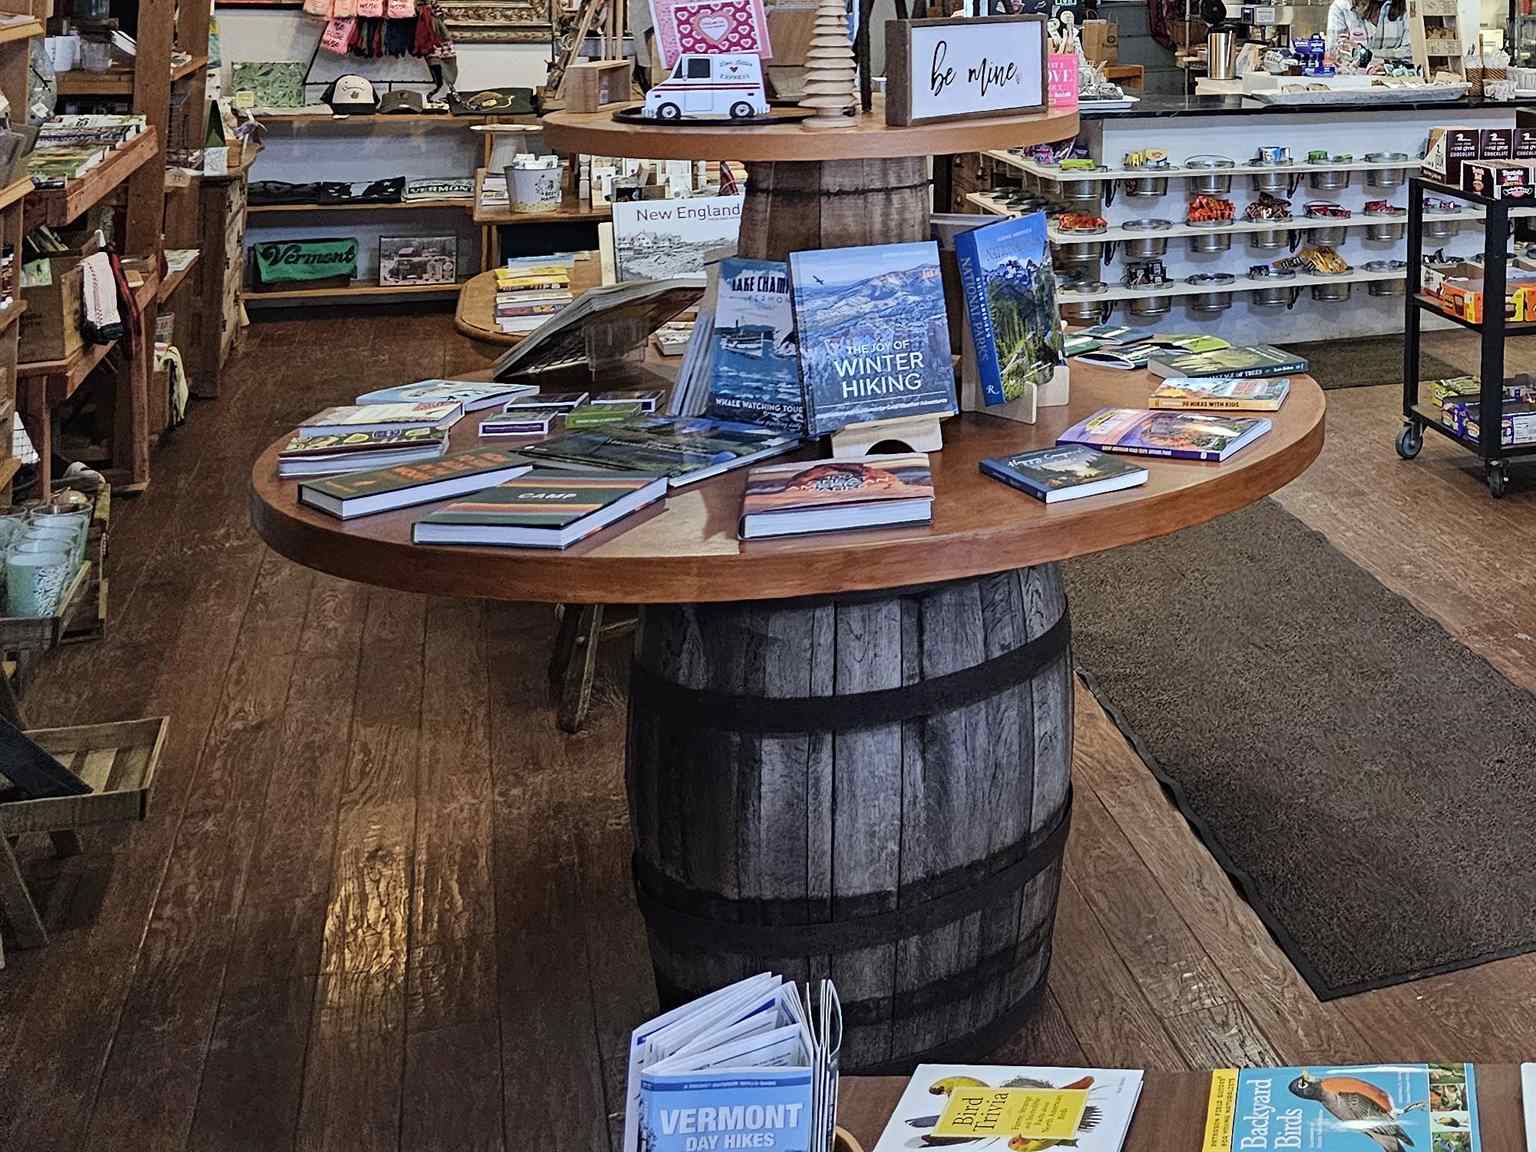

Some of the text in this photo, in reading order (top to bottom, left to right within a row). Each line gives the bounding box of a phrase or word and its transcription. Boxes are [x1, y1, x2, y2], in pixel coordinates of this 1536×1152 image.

[930, 40, 1018, 97] be mine
[636, 203, 741, 223] New England
[268, 244, 357, 266] Vermont
[731, 275, 754, 292] LAKE
[847, 339, 910, 354] THE JOY OF
[833, 351, 924, 377] WINTER
[841, 372, 923, 399] HIKING
[517, 491, 577, 501] CAMP
[659, 1103, 804, 1136] VERMONT
[952, 1096, 984, 1127] Bird
[973, 1092, 1009, 1133] Trivia
[1240, 1078, 1276, 1150] Backyard
[686, 1132, 777, 1152] DAY HIKES
[1274, 1108, 1304, 1150] Birds
